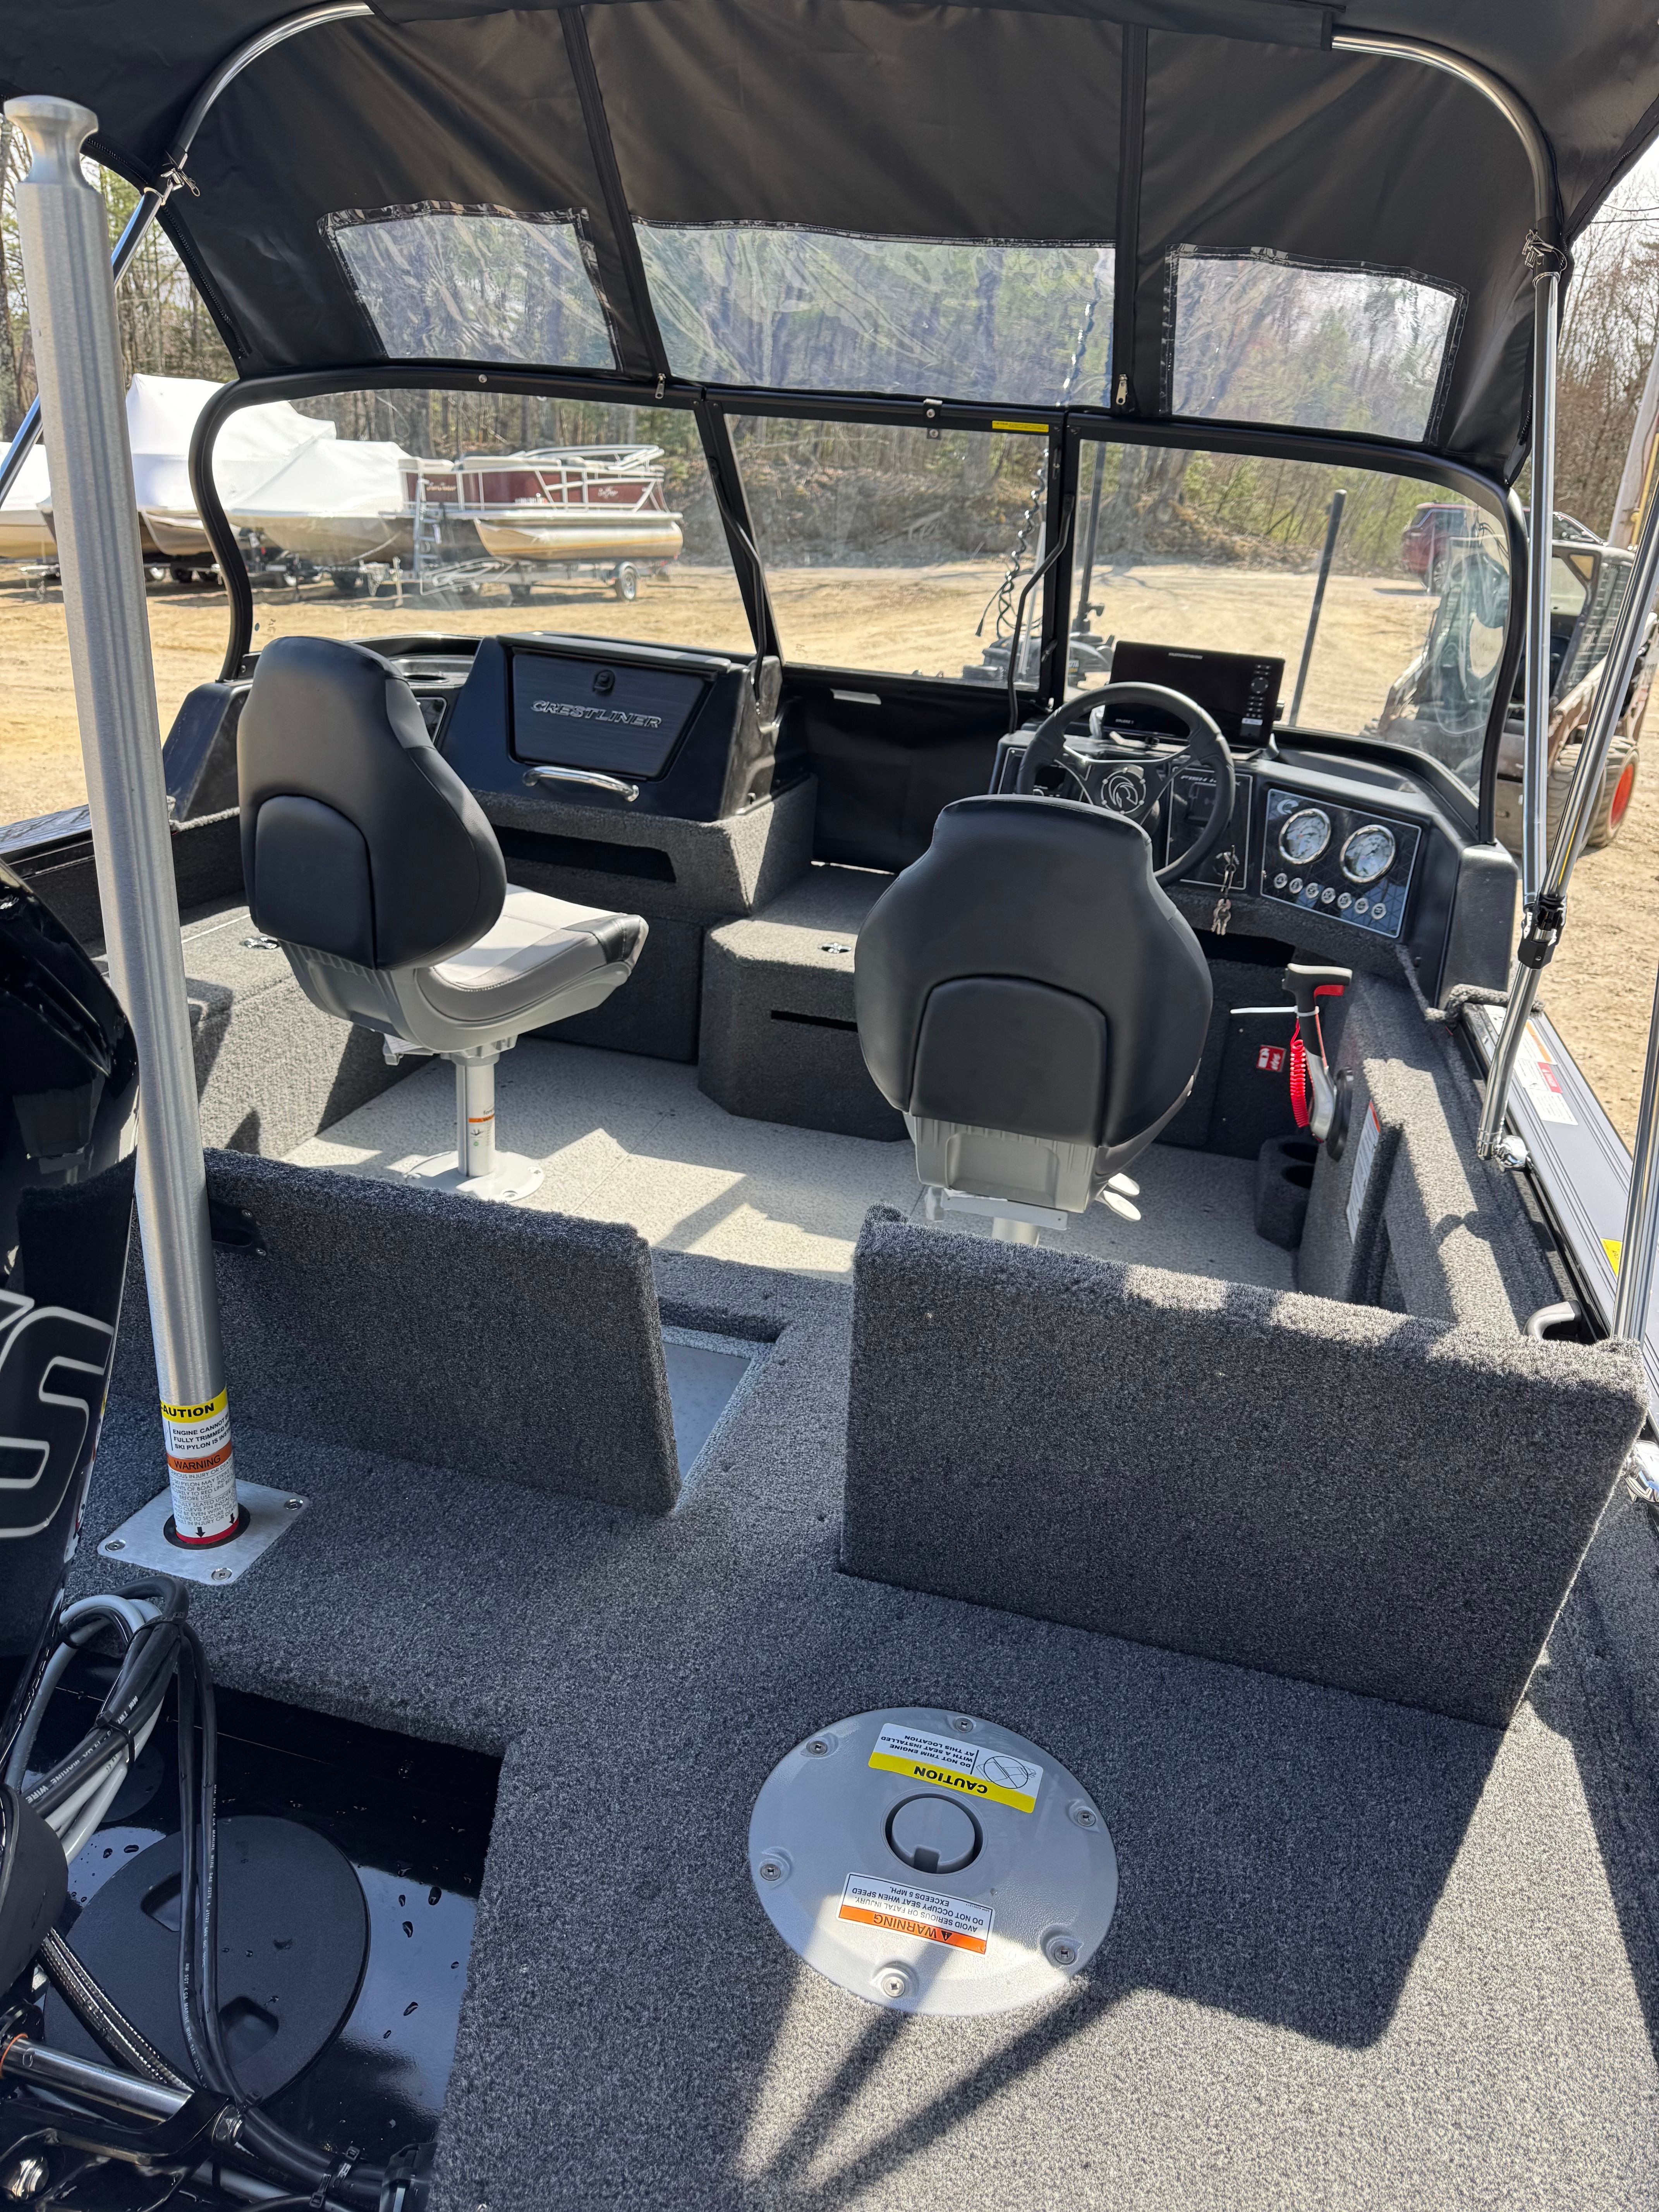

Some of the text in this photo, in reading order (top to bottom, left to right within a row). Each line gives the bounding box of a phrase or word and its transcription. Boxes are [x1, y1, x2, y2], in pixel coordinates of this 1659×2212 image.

[531, 700, 661, 728] CRESTLINER
[200, 1417, 225, 1434] CANNOT
[196, 1426, 224, 1442] TRIMMED
[187, 1441, 210, 1450] PYLON
[174, 1455, 221, 1470] WARNING
[214, 1483, 225, 1492] LINE
[203, 1510, 224, 1520] SECURE
[881, 1736, 922, 1748] INSTALLED
[905, 1736, 943, 1748] LOCATION
[890, 1744, 919, 1754] ENGINE
[945, 1745, 962, 1753] THIS
[953, 1753, 972, 1762] WITH
[50, 1759, 80, 1784] MARINE
[914, 1766, 988, 1794] CAUTION
[25, 1785, 49, 1803] WIRE
[852, 1888, 877, 1898] SPEED
[890, 1886, 907, 1896] MPH.
[855, 1897, 882, 1908] INJURY.
[878, 1893, 900, 1903] WHEN
[902, 1898, 921, 1908] SEAT
[915, 1893, 950, 1907] EXCEEDS
[884, 1903, 906, 1913] FATAL
[922, 1904, 953, 1917] OCCUPY
[921, 1912, 953, 1926] SERIOUS
[955, 1912, 971, 1922] NOT
[874, 1914, 937, 1939] WARNING
[955, 1922, 978, 1932] AVOID
